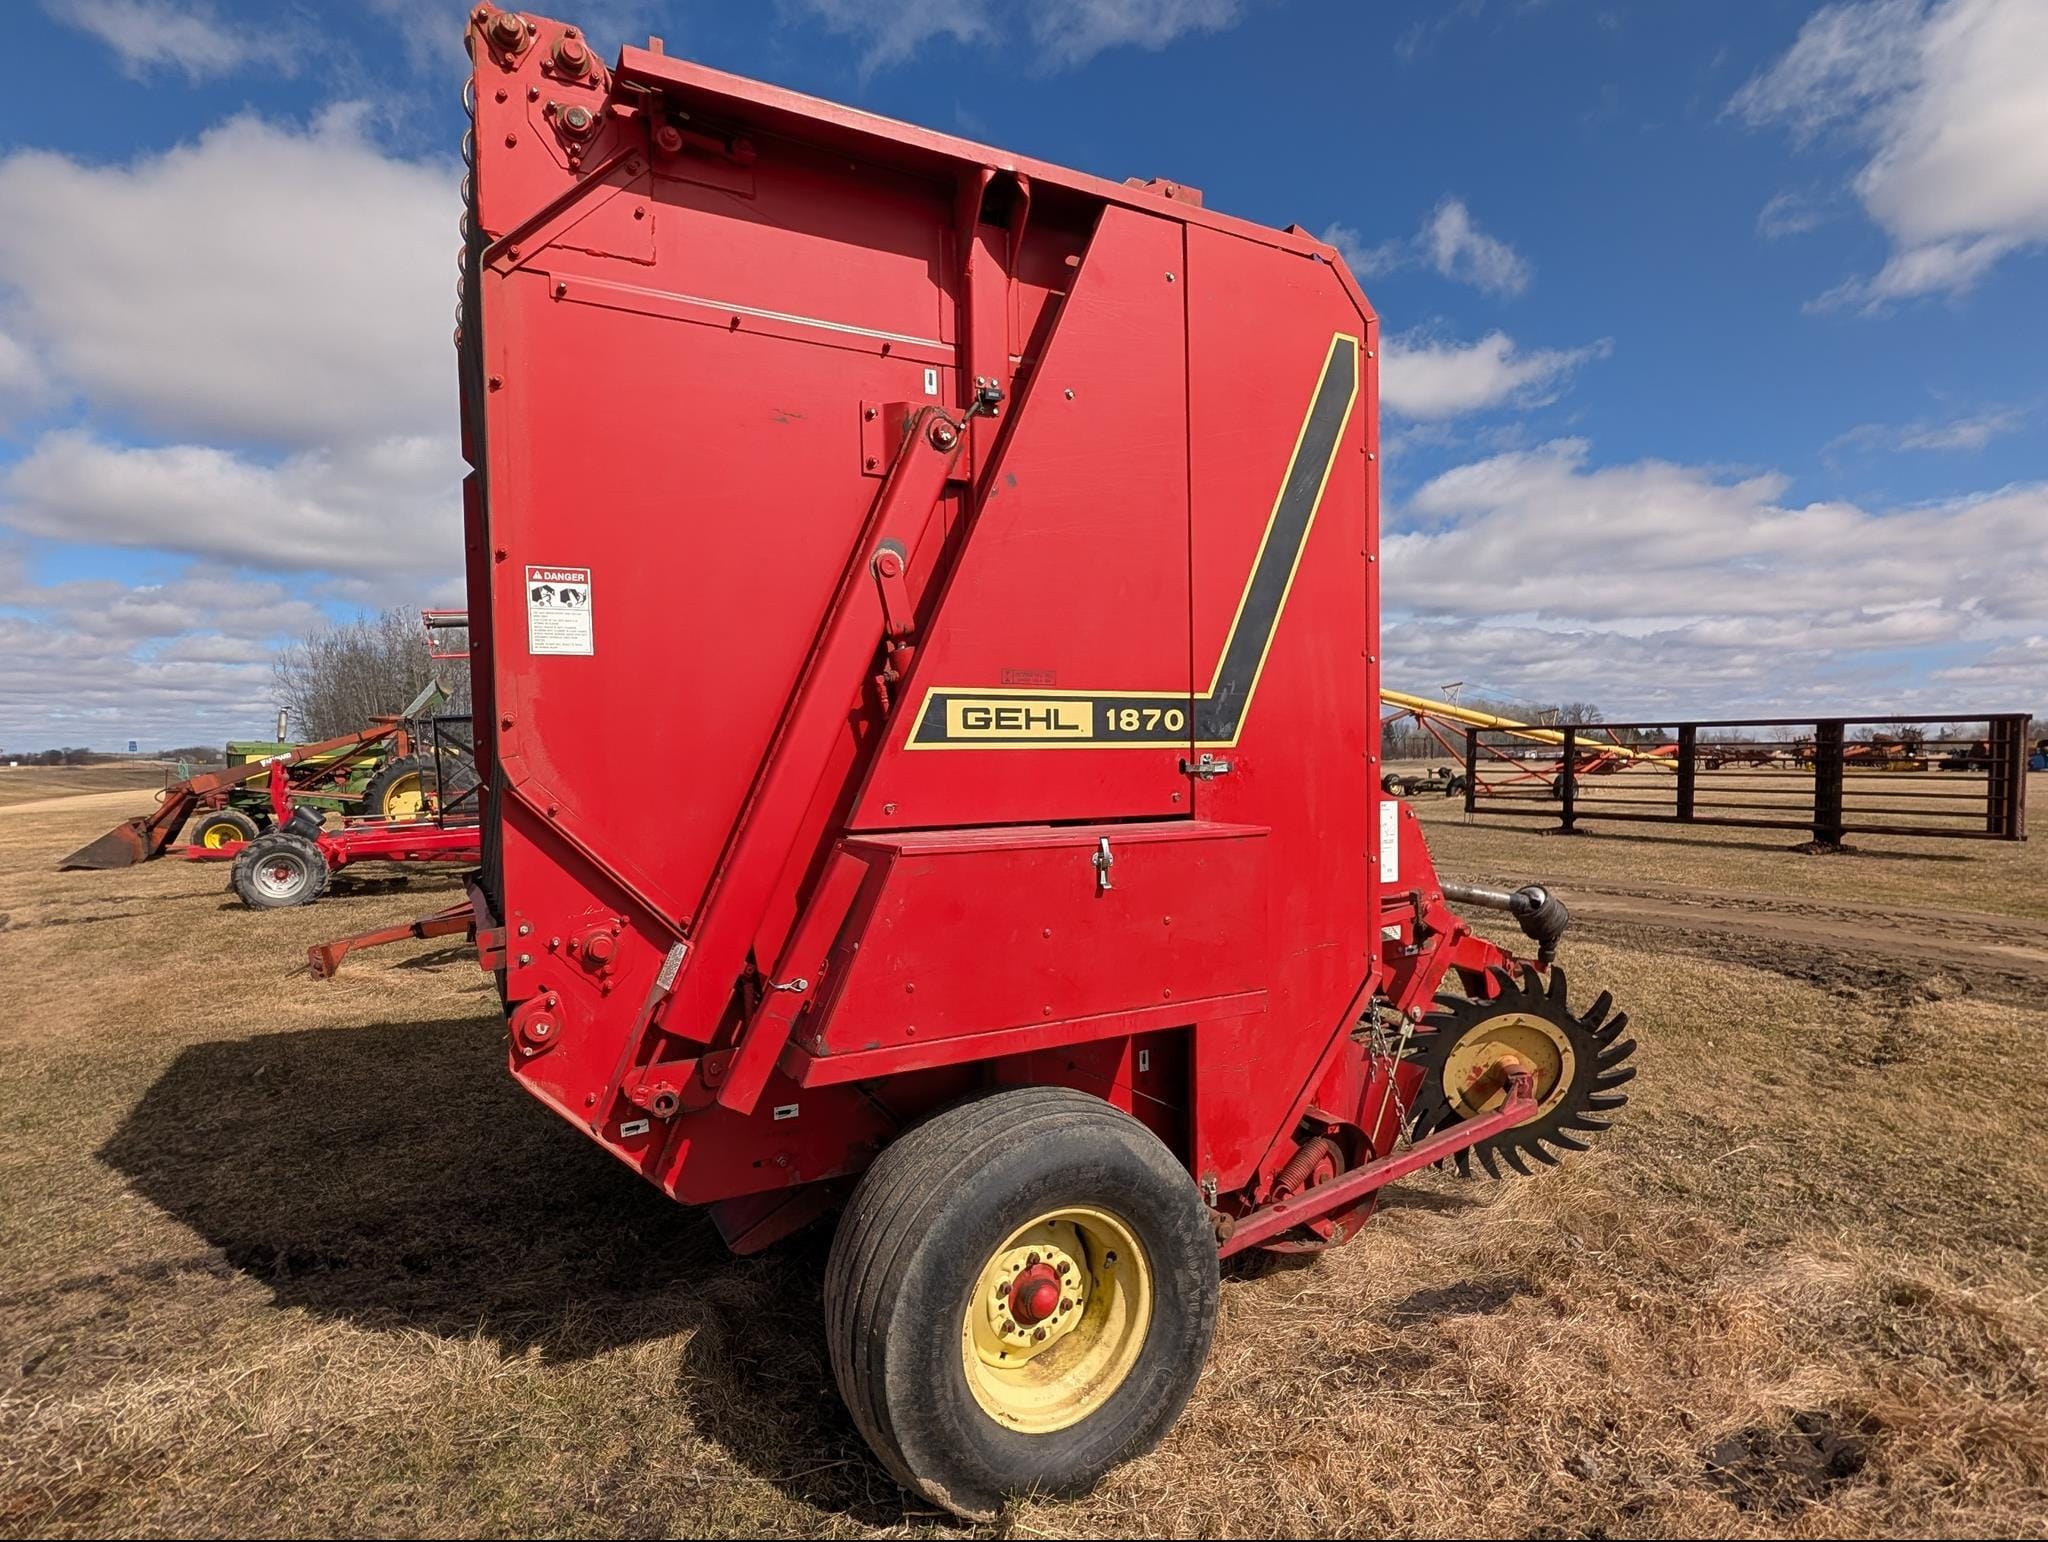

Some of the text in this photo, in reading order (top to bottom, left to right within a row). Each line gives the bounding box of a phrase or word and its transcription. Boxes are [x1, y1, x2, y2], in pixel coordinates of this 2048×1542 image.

[544, 572, 584, 581] DANGER
[962, 707, 1184, 731] GEHL 1870
